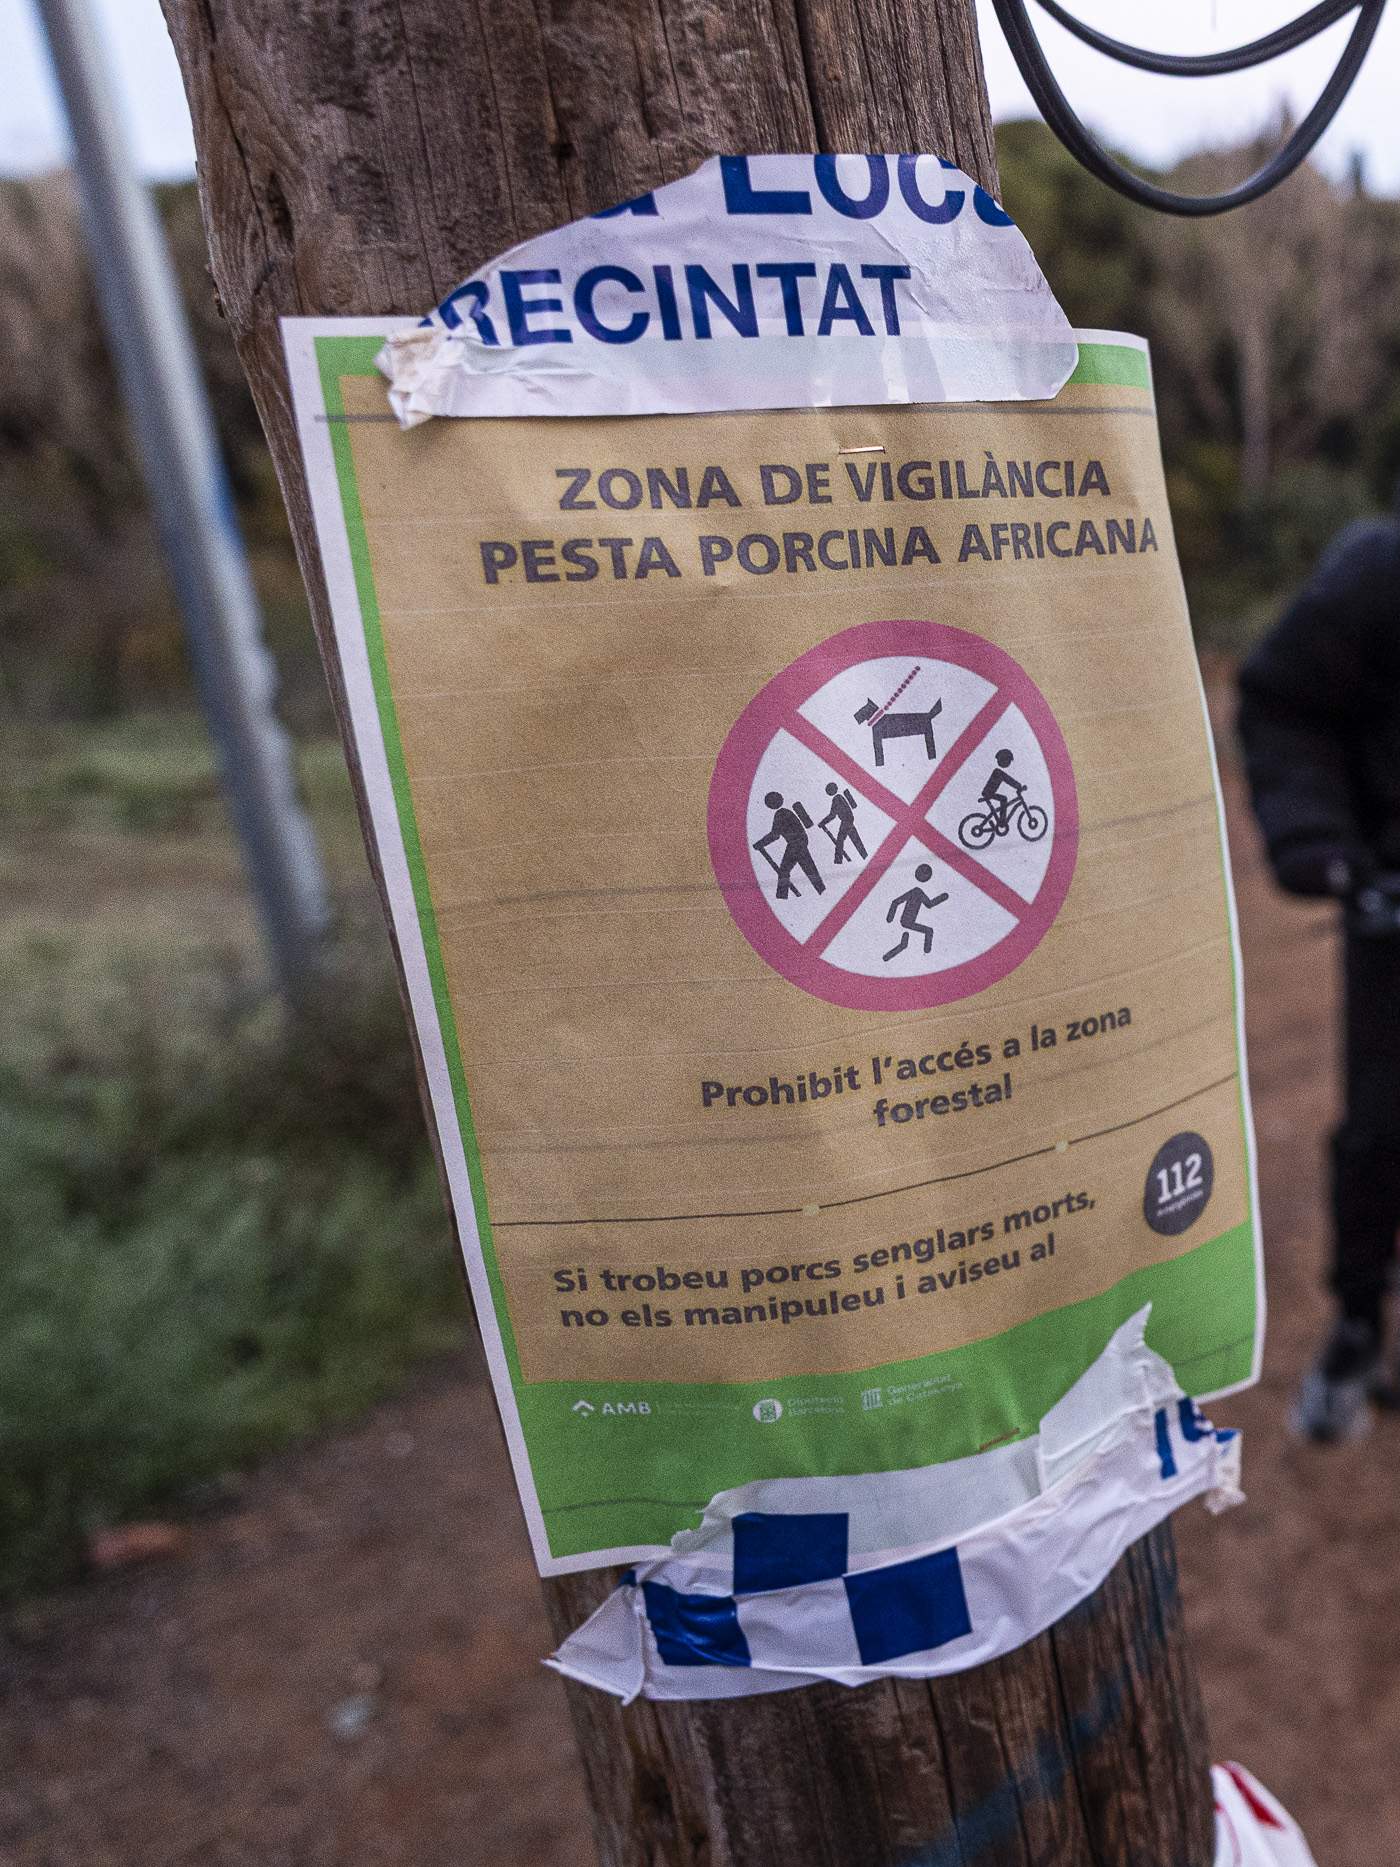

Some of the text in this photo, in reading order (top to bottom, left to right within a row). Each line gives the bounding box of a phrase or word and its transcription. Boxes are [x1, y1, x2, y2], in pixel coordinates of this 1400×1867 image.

[418, 261, 911, 346] RECINTAT
[555, 451, 1111, 510] ZONA DE VIGILÀNCIA
[480, 518, 1158, 584] PESTA PORCINA AFRICANA
[701, 1066, 860, 1108] Prohibit
[1003, 1037, 1021, 1059] a
[1030, 1025, 1057, 1052] la
[1065, 1007, 1132, 1043] zona
[874, 1074, 1013, 1126] forestal
[1156, 1153, 1203, 1204] 112
[553, 1190, 1096, 1296] Si trobeu porcs senglars morts,
[561, 1233, 1056, 1328] no els manipuleu i aviseu al
[602, 1402, 651, 1415] AMB
